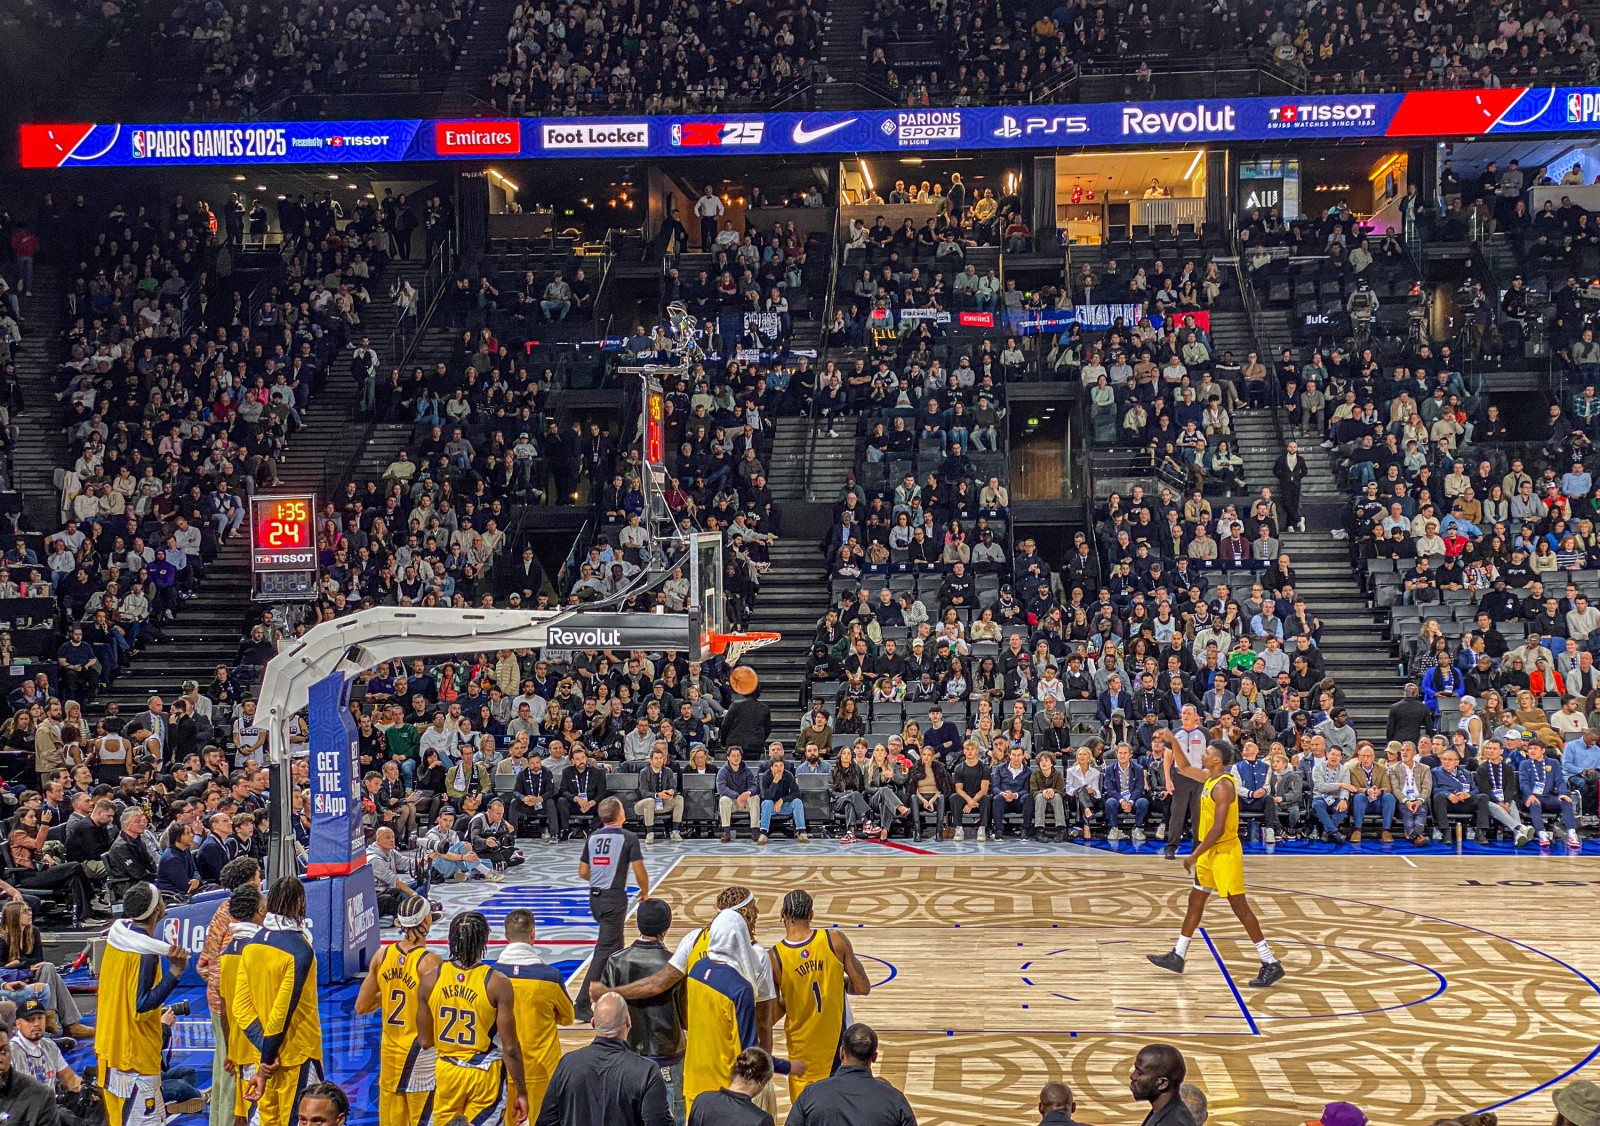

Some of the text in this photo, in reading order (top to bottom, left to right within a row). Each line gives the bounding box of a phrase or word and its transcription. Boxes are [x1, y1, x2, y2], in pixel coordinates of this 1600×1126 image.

[899, 113, 961, 125] PARIONS
[1122, 105, 1235, 135] Revolut
[1298, 104, 1376, 120] TISSOT
[343, 136, 389, 145] TISSOT
[445, 130, 512, 147] Emirates
[547, 127, 583, 144] Foot
[902, 127, 957, 137] SPORT
[146, 128, 287, 157] PARIS GAMES 2025
[277, 502, 306, 521] 1:35
[269, 522, 299, 545] 24
[272, 554, 313, 563] TISSOT
[549, 628, 621, 646] Revolut
[317, 751, 340, 772] GET
[318, 773, 341, 792] THE
[325, 794, 346, 816] App
[595, 838, 612, 854] 36
[795, 960, 824, 977] TOPPIN
[382, 968, 417, 990] NEMBARD
[442, 985, 478, 1003] NESMITH
[812, 980, 822, 1014] 1
[387, 989, 406, 1026] 2
[438, 1006, 476, 1046] 23
